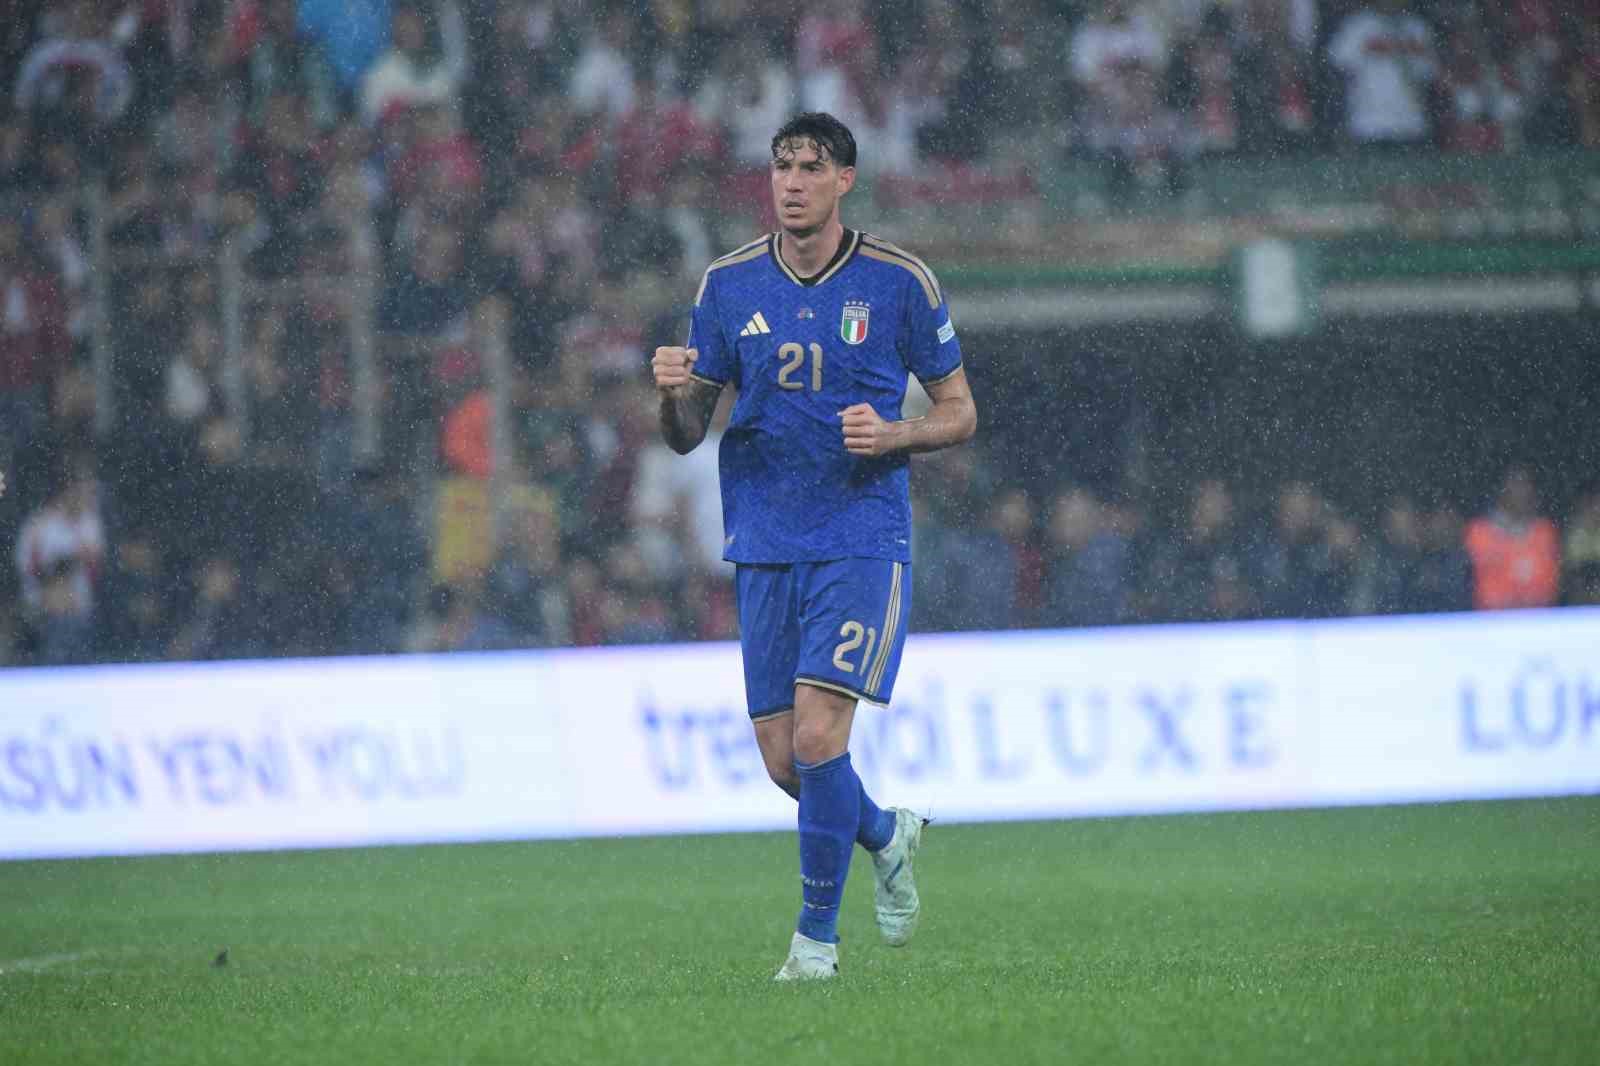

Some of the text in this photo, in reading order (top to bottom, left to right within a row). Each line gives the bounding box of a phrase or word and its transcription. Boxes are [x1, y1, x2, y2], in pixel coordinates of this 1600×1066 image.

[778, 342, 823, 391] 21
[832, 620, 876, 676] 21
[0, 713, 138, 813] SÜN
[970, 682, 1276, 777] LUXE
